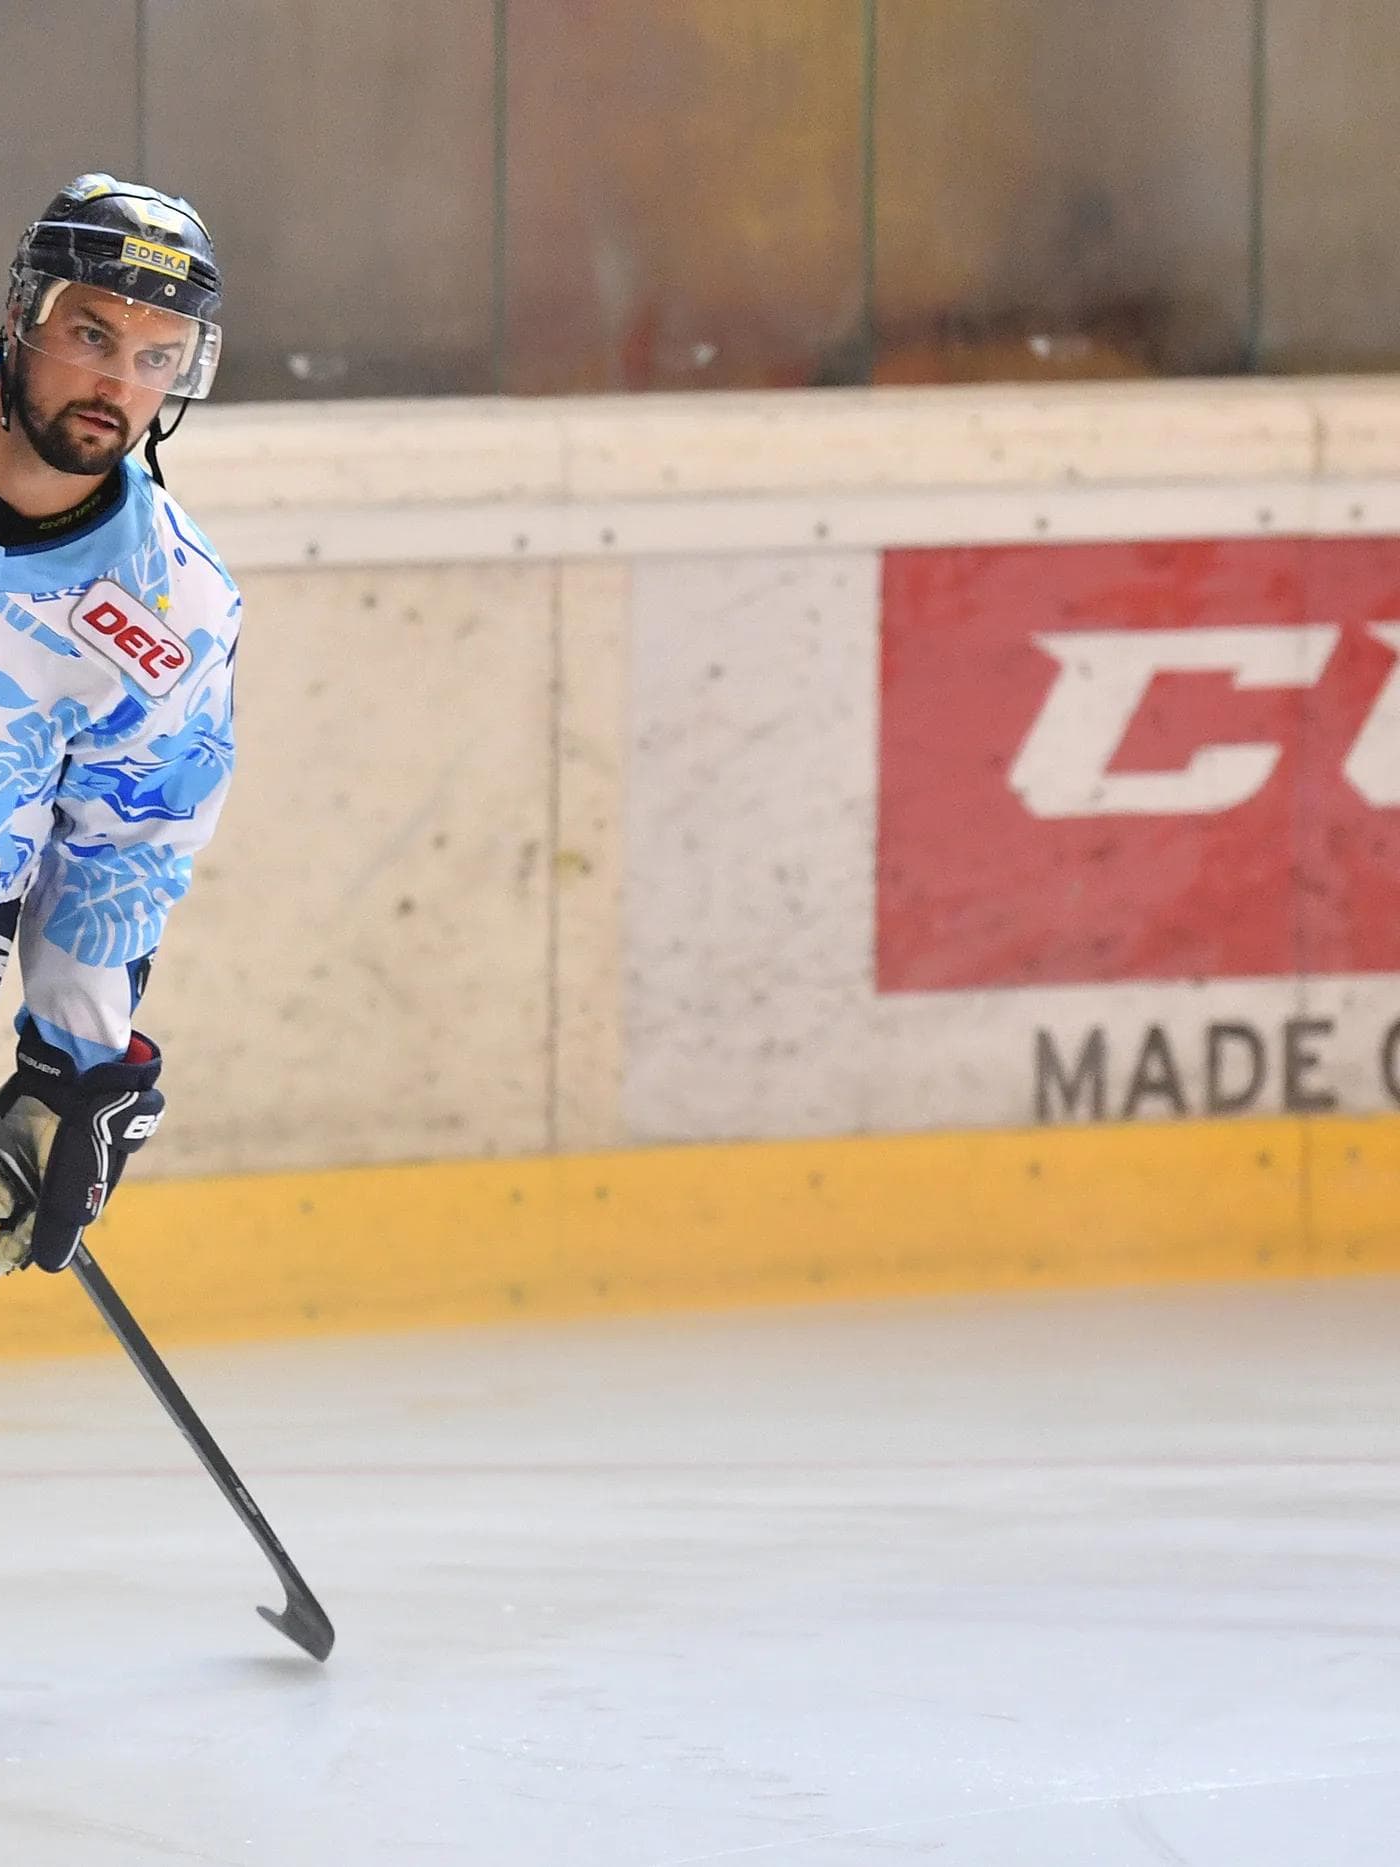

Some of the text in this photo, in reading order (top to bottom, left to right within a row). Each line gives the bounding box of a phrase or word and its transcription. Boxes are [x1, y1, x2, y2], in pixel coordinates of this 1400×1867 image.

[124, 242, 188, 273] EDEKA
[1006, 621, 1400, 821] C
[1033, 1018, 1337, 1124] MADE
